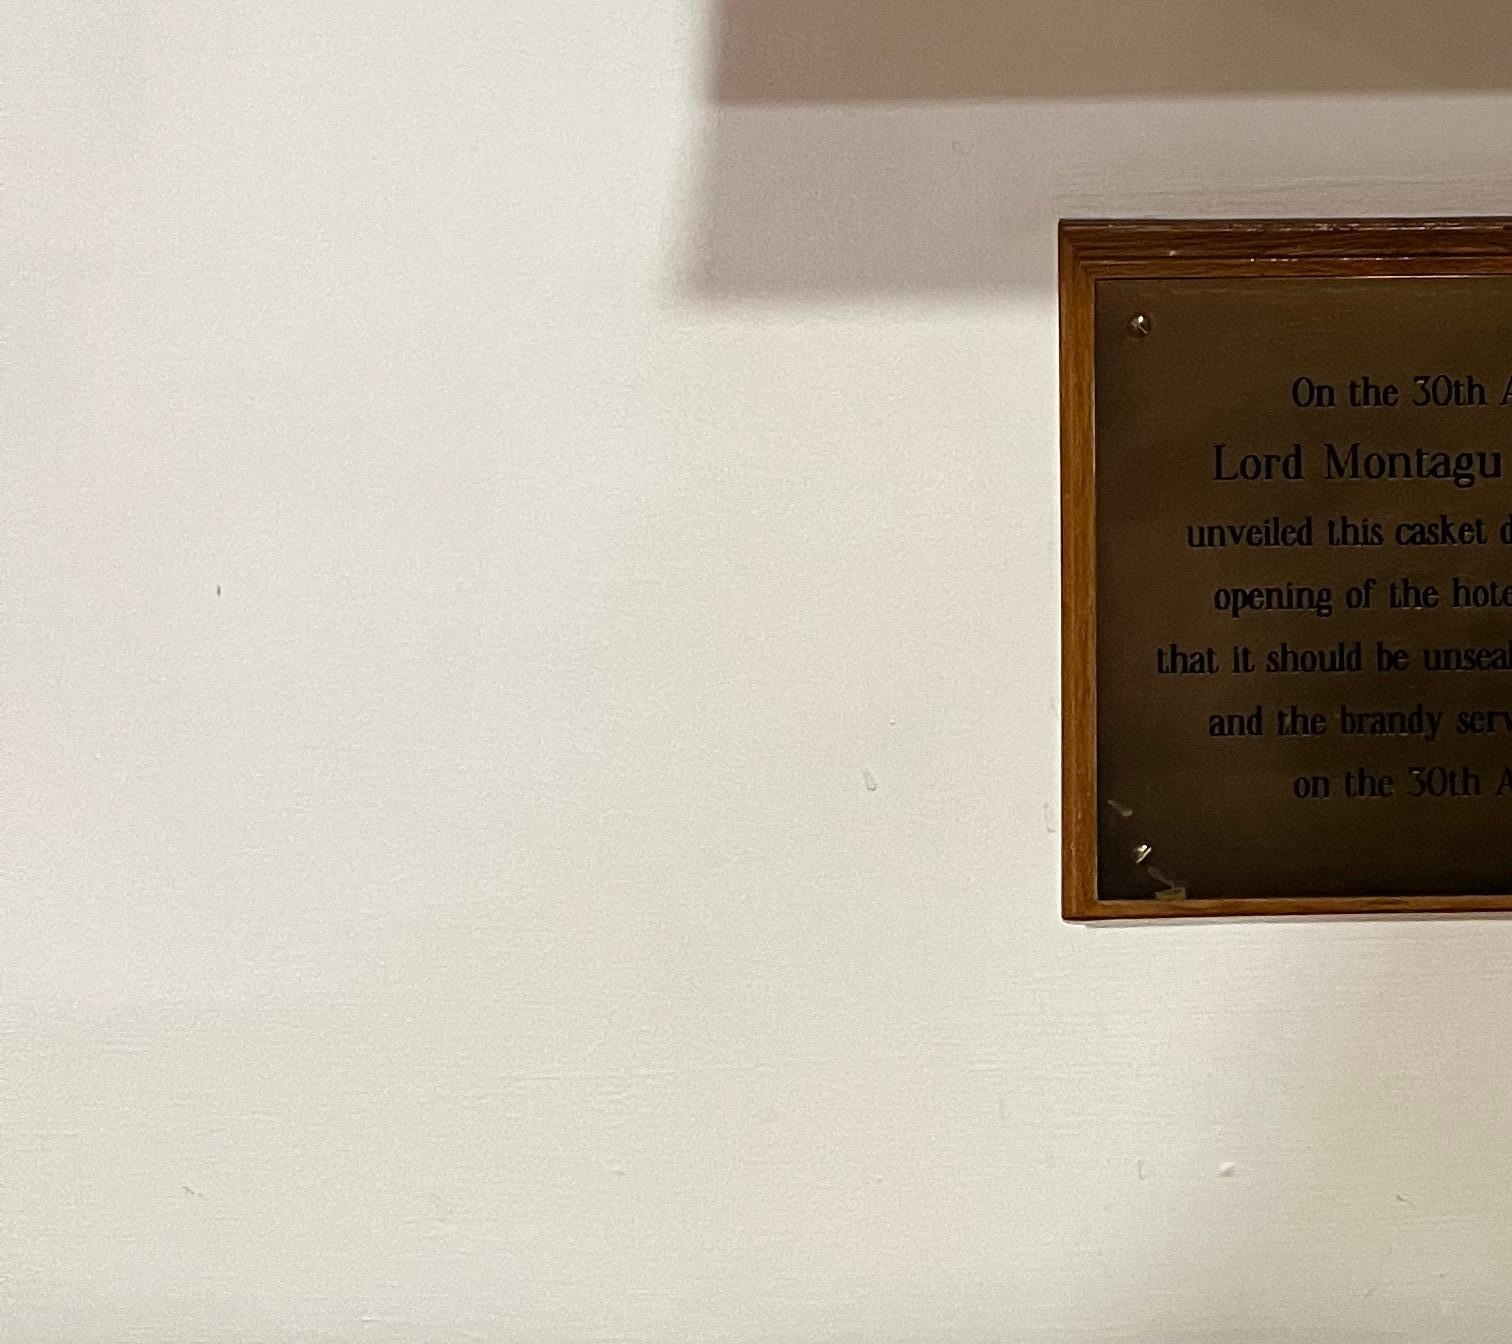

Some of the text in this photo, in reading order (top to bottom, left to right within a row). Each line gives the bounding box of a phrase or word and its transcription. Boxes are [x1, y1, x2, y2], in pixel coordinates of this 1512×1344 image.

[1291, 376, 1336, 408] On
[1348, 375, 1399, 407] the
[1411, 374, 1487, 407] 30th
[1212, 443, 1304, 481] Lord
[1323, 442, 1502, 489] Montagu
[1185, 514, 1314, 548] unveiled
[1327, 515, 1385, 546] this
[1394, 513, 1488, 546] casket
[1213, 581, 1333, 619] opening
[1345, 577, 1378, 609] of
[1389, 577, 1440, 609] the
[1156, 642, 1220, 675] that
[1231, 645, 1256, 674] it
[1265, 641, 1362, 673] should
[1376, 640, 1410, 673] be
[1208, 704, 1263, 737] and
[1277, 705, 1327, 736] the
[1340, 703, 1444, 742] brandy
[1293, 775, 1330, 799] on
[1345, 766, 1394, 798] the
[1408, 766, 1481, 797] 30th
